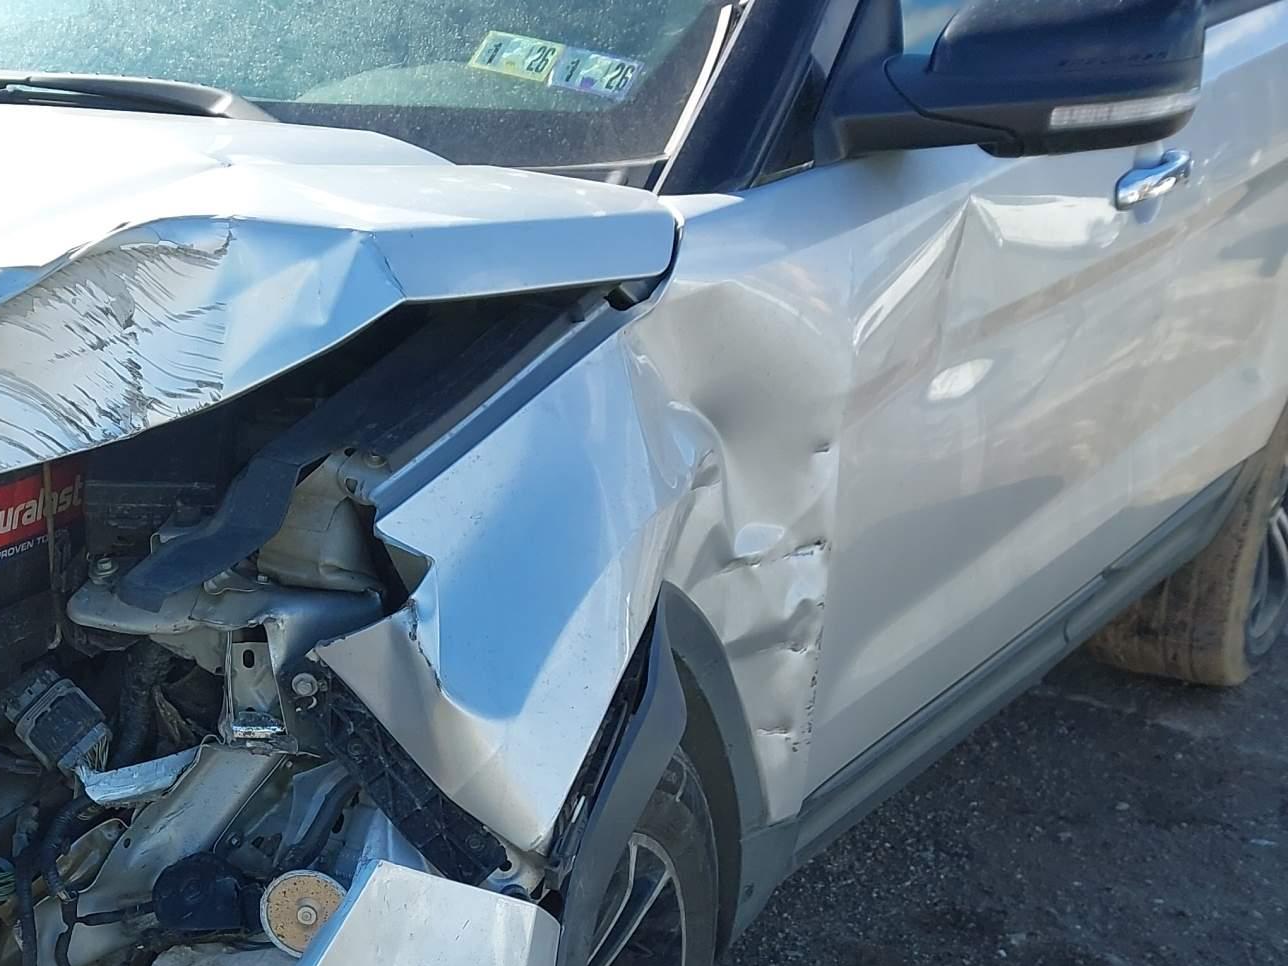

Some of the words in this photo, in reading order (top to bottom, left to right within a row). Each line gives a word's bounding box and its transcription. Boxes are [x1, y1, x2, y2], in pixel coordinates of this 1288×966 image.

[487, 42, 503, 65] 1
[525, 45, 557, 73] 26
[565, 58, 581, 82] 1
[604, 63, 634, 91] 26
